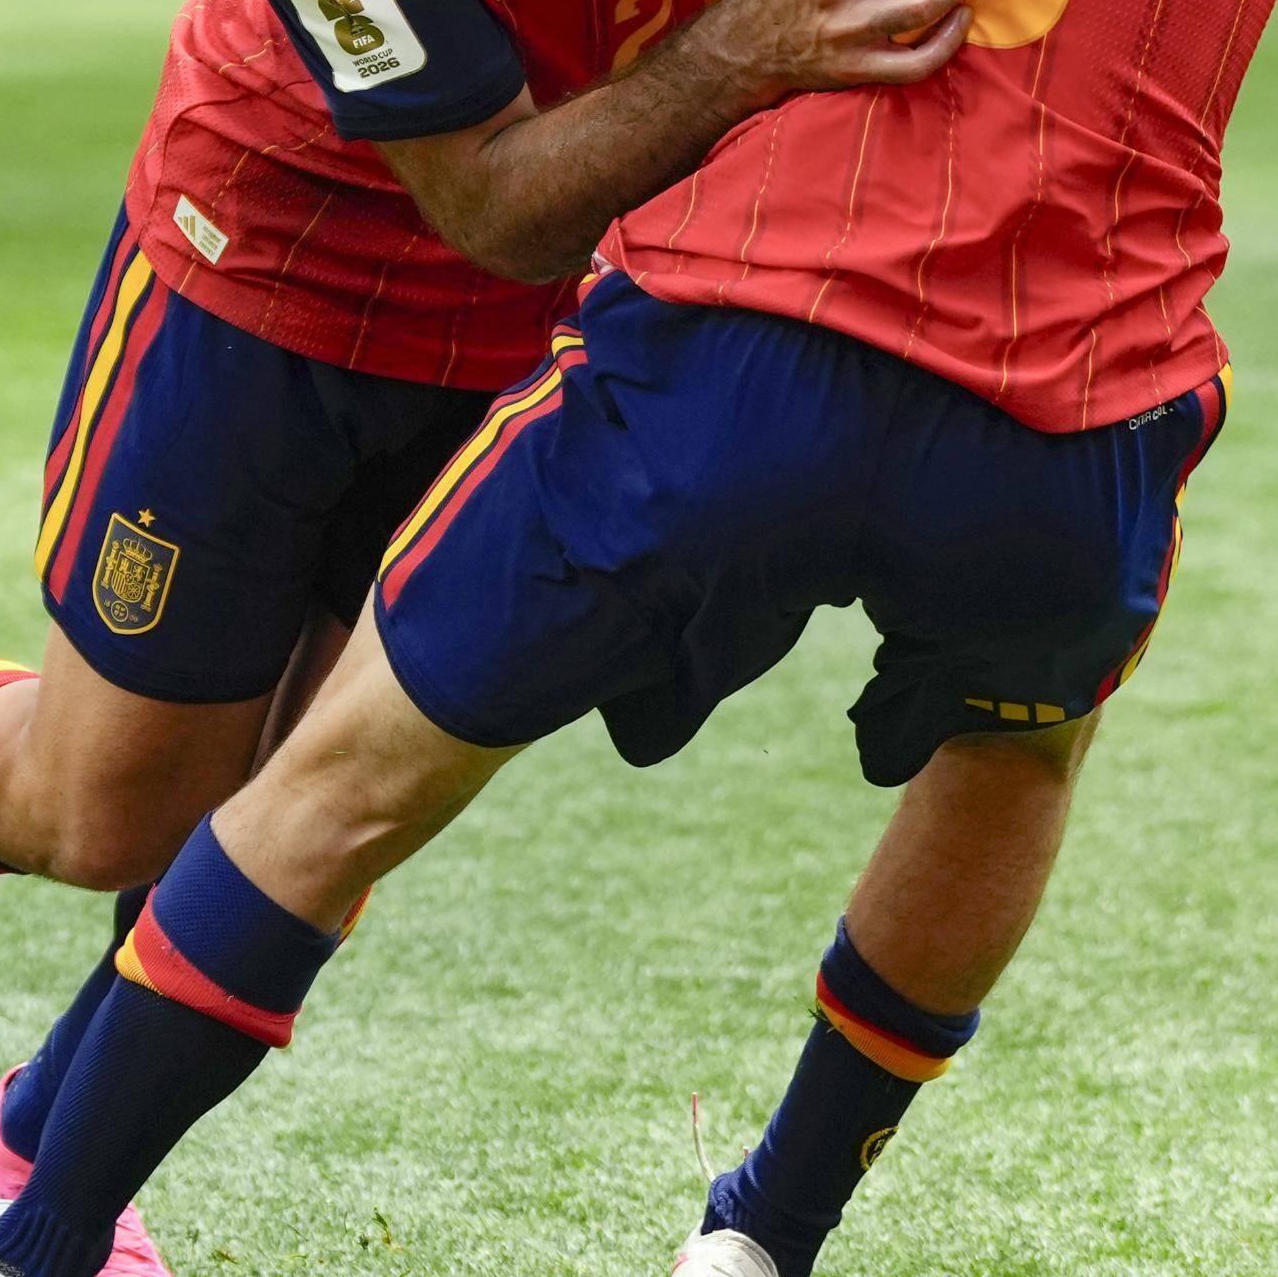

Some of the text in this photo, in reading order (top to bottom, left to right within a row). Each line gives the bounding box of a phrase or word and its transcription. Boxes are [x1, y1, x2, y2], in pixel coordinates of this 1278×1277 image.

[352, 34, 376, 49] FIFA
[352, 48, 393, 67] WORLD CUP
[357, 56, 401, 78] 2026
